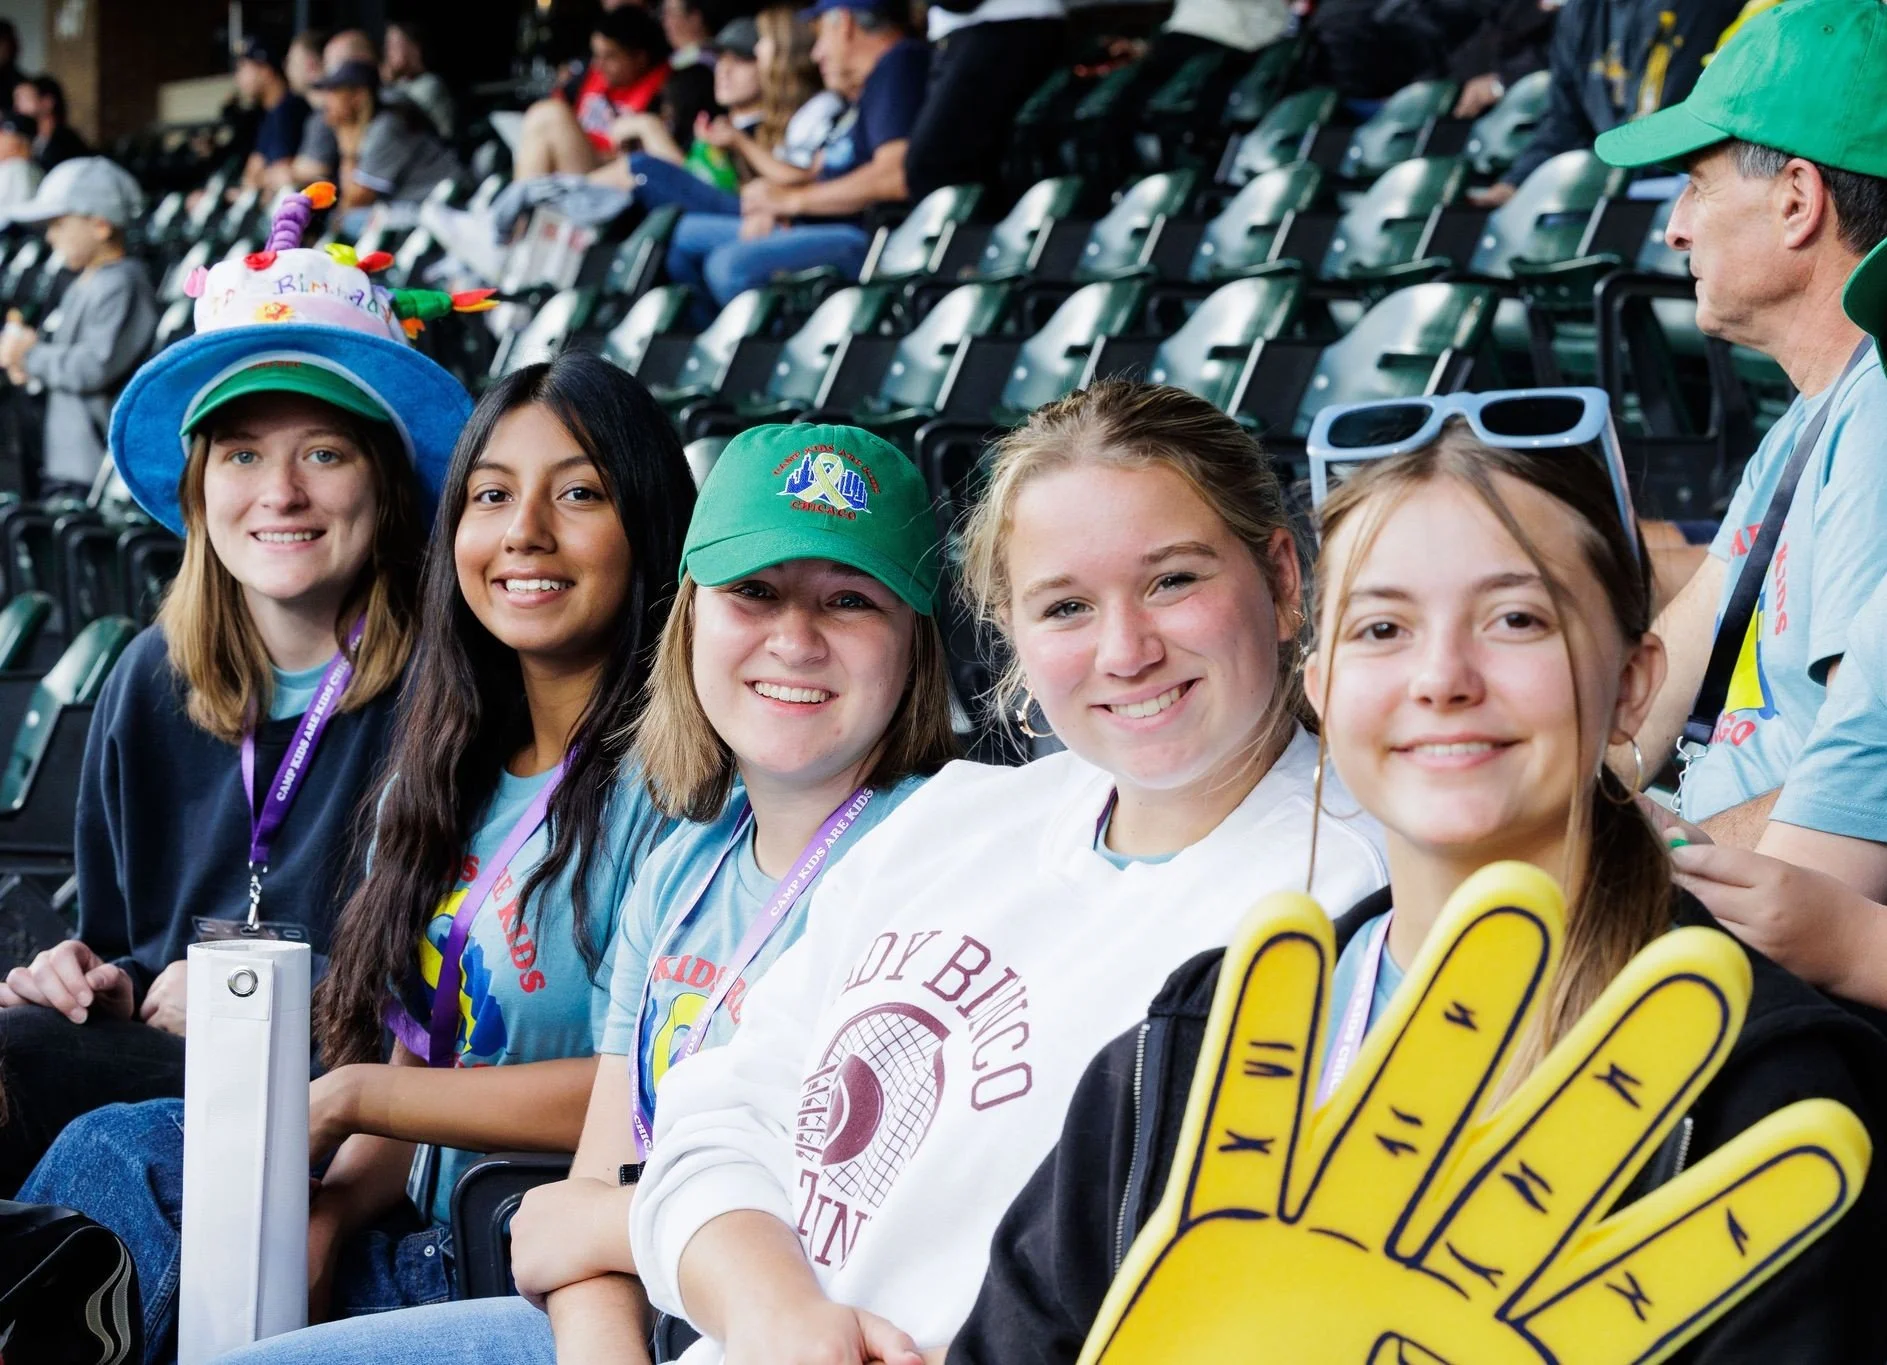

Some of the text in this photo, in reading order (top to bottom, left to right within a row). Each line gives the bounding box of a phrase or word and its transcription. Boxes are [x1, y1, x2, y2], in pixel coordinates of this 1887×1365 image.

[790, 500, 857, 520] CHICAGO
[276, 767, 297, 801] CAMP
[290, 738, 310, 770] KIDS
[303, 712, 321, 742] ARE
[314, 684, 335, 715] KIDS
[770, 788, 874, 917] CAMP KIDS ARE KIDS
[498, 895, 546, 994] KIDS
